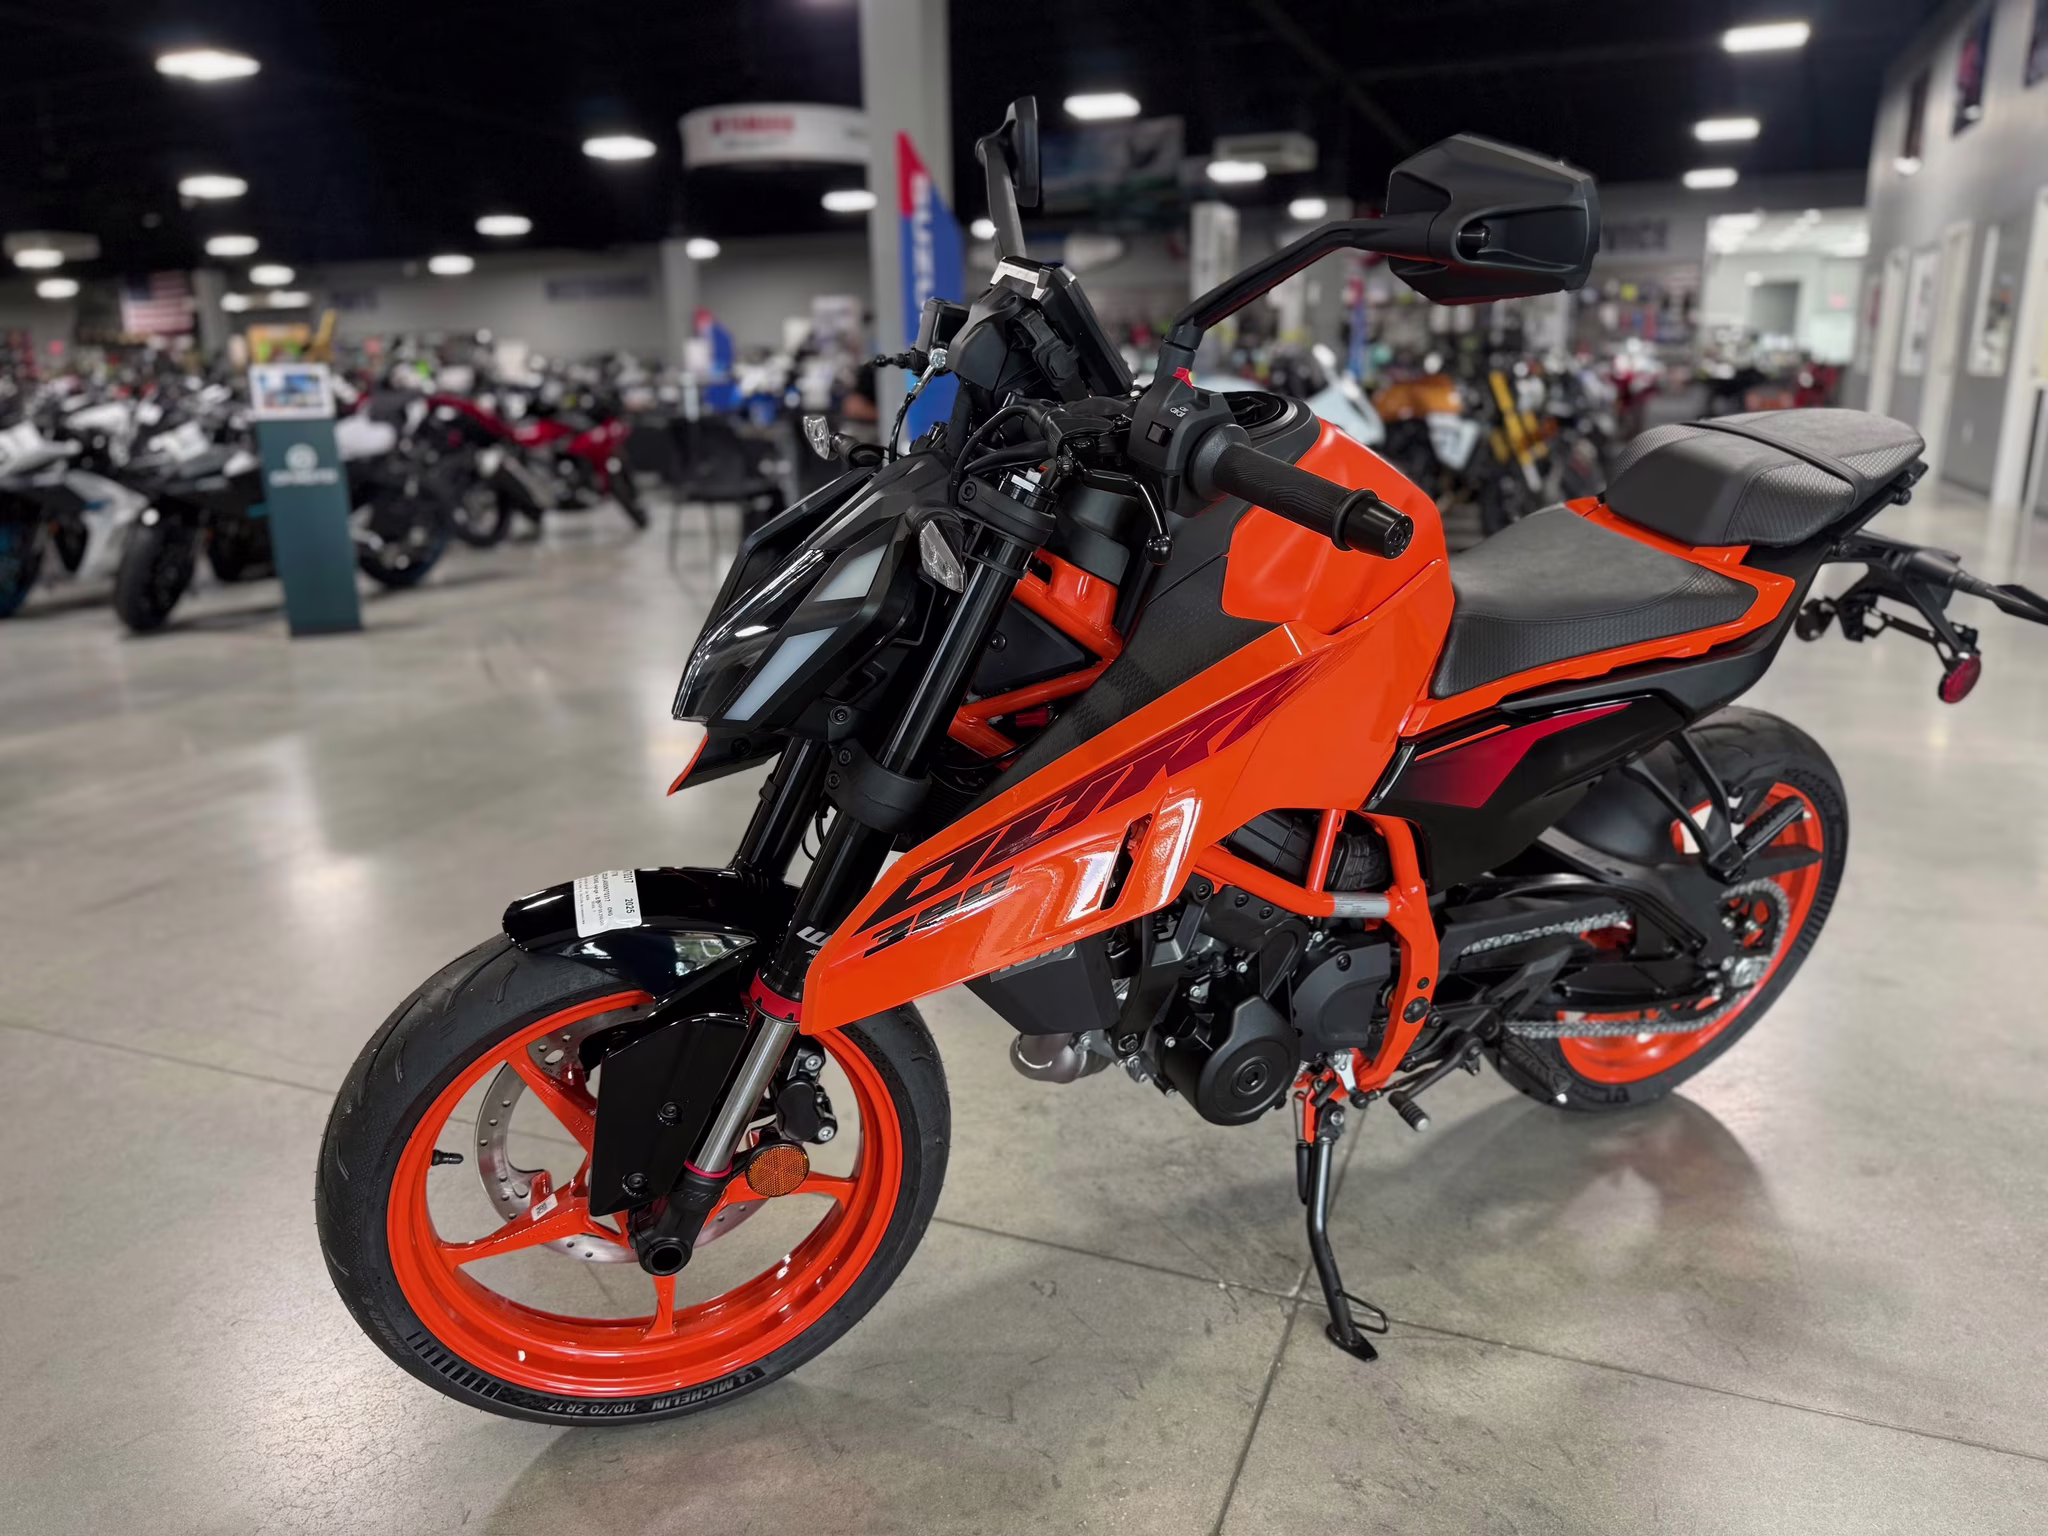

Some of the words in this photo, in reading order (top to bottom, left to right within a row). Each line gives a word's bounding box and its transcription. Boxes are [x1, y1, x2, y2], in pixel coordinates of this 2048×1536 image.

[850, 652, 1322, 938] DUKE
[625, 897, 635, 914] 2025
[862, 865, 1015, 958] 390
[651, 1378, 735, 1411] MICHELIN
[547, 1401, 565, 1412] 17
[566, 1403, 586, 1414] ZR
[589, 1402, 637, 1415] 110/70
